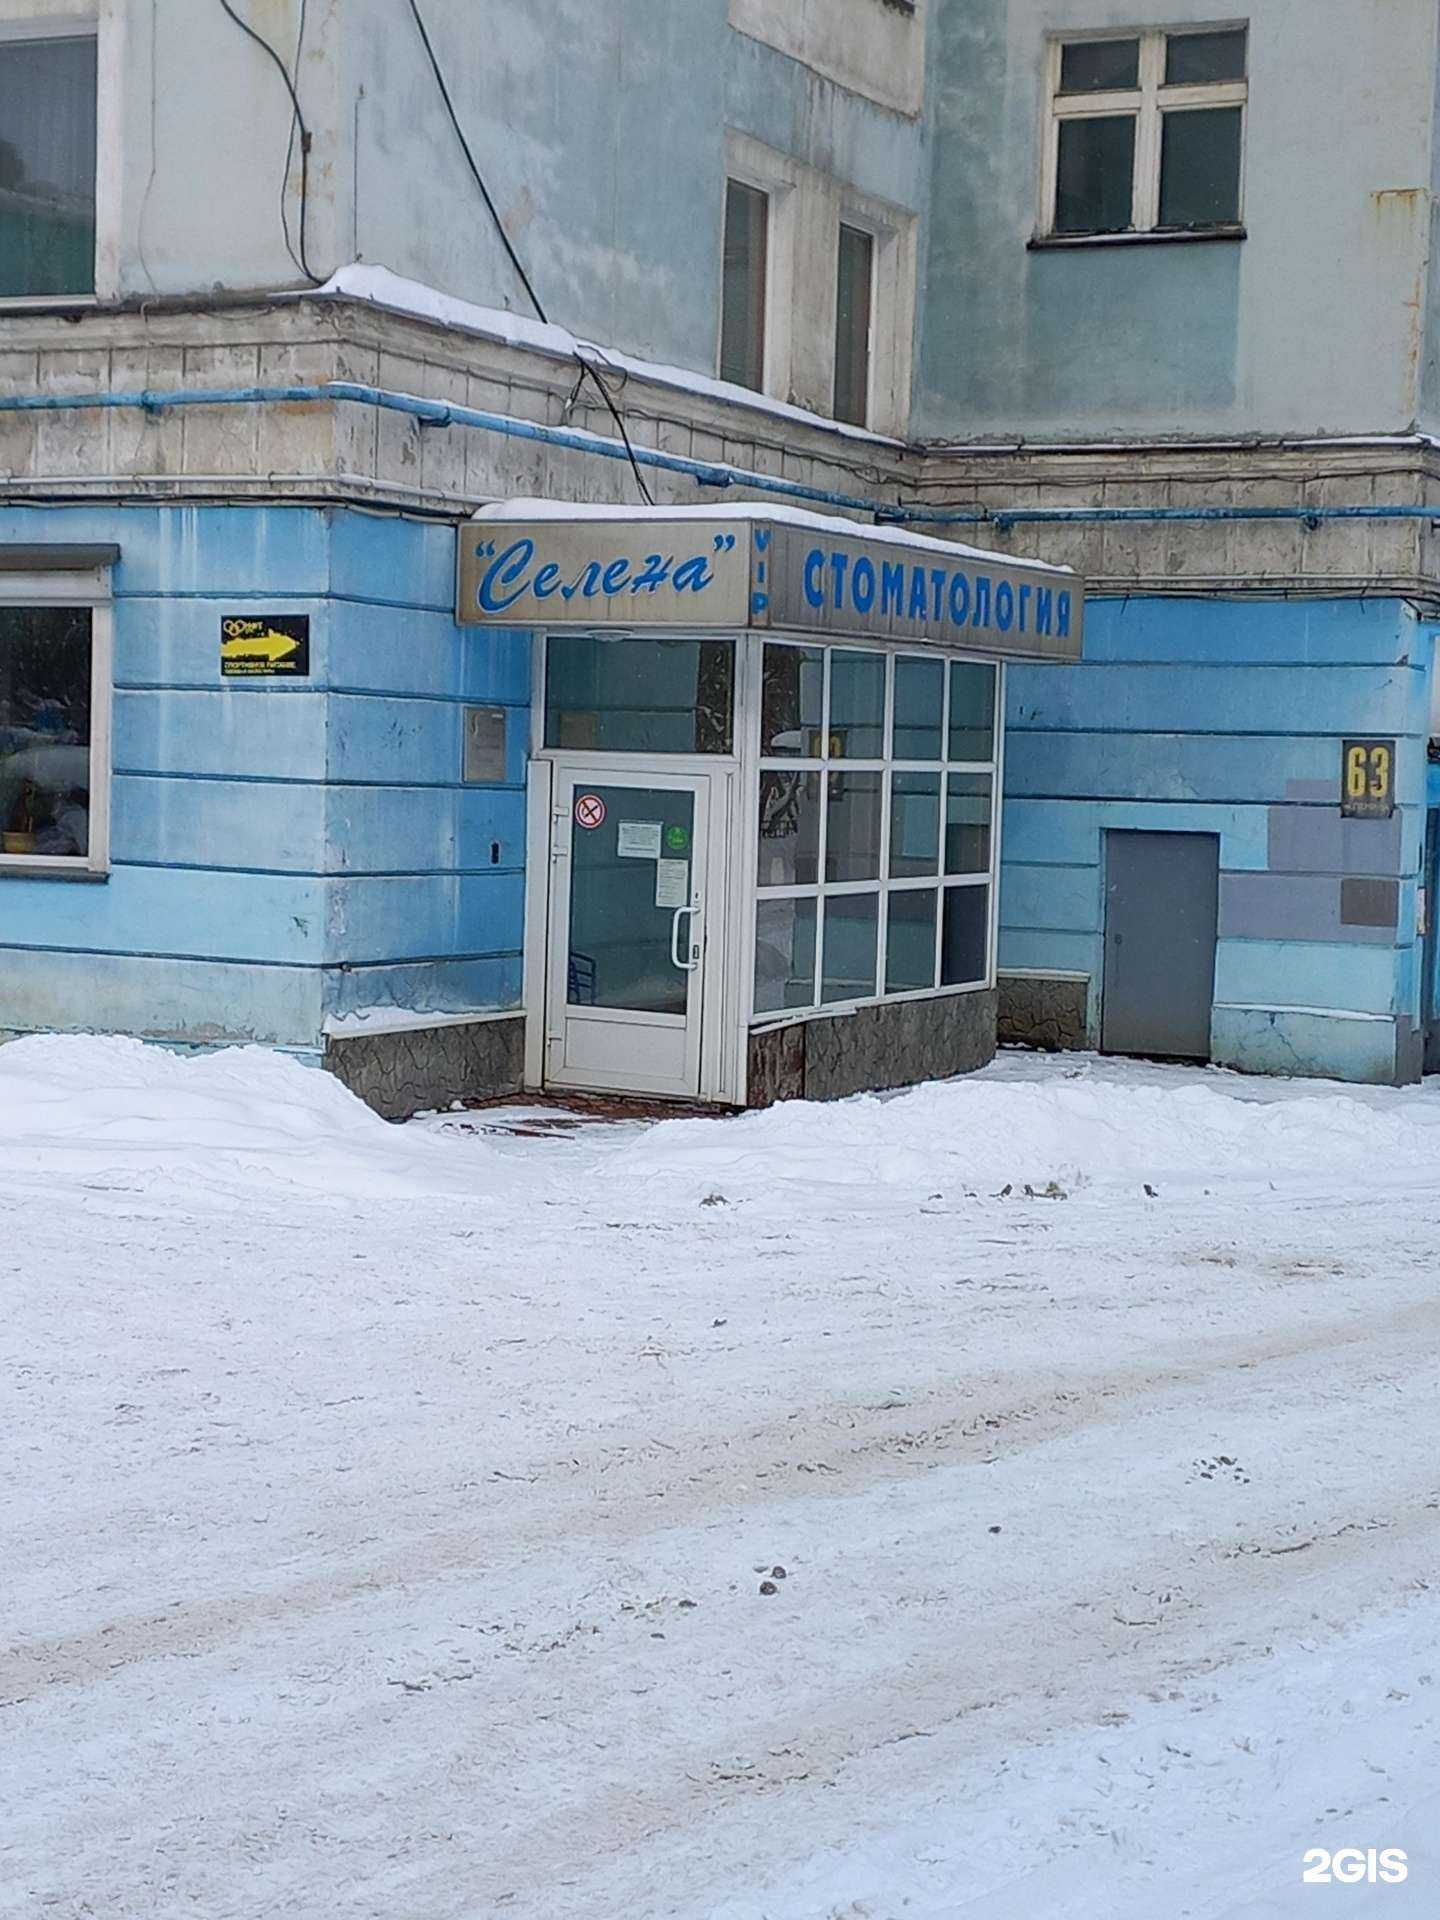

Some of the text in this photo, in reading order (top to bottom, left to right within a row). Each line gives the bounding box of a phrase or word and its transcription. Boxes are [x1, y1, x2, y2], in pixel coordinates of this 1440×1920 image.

[751, 528, 773, 615] VIP
[803, 549, 1071, 637] СТОМАТОЛОГИЯ
[1347, 746, 1389, 798] 63
